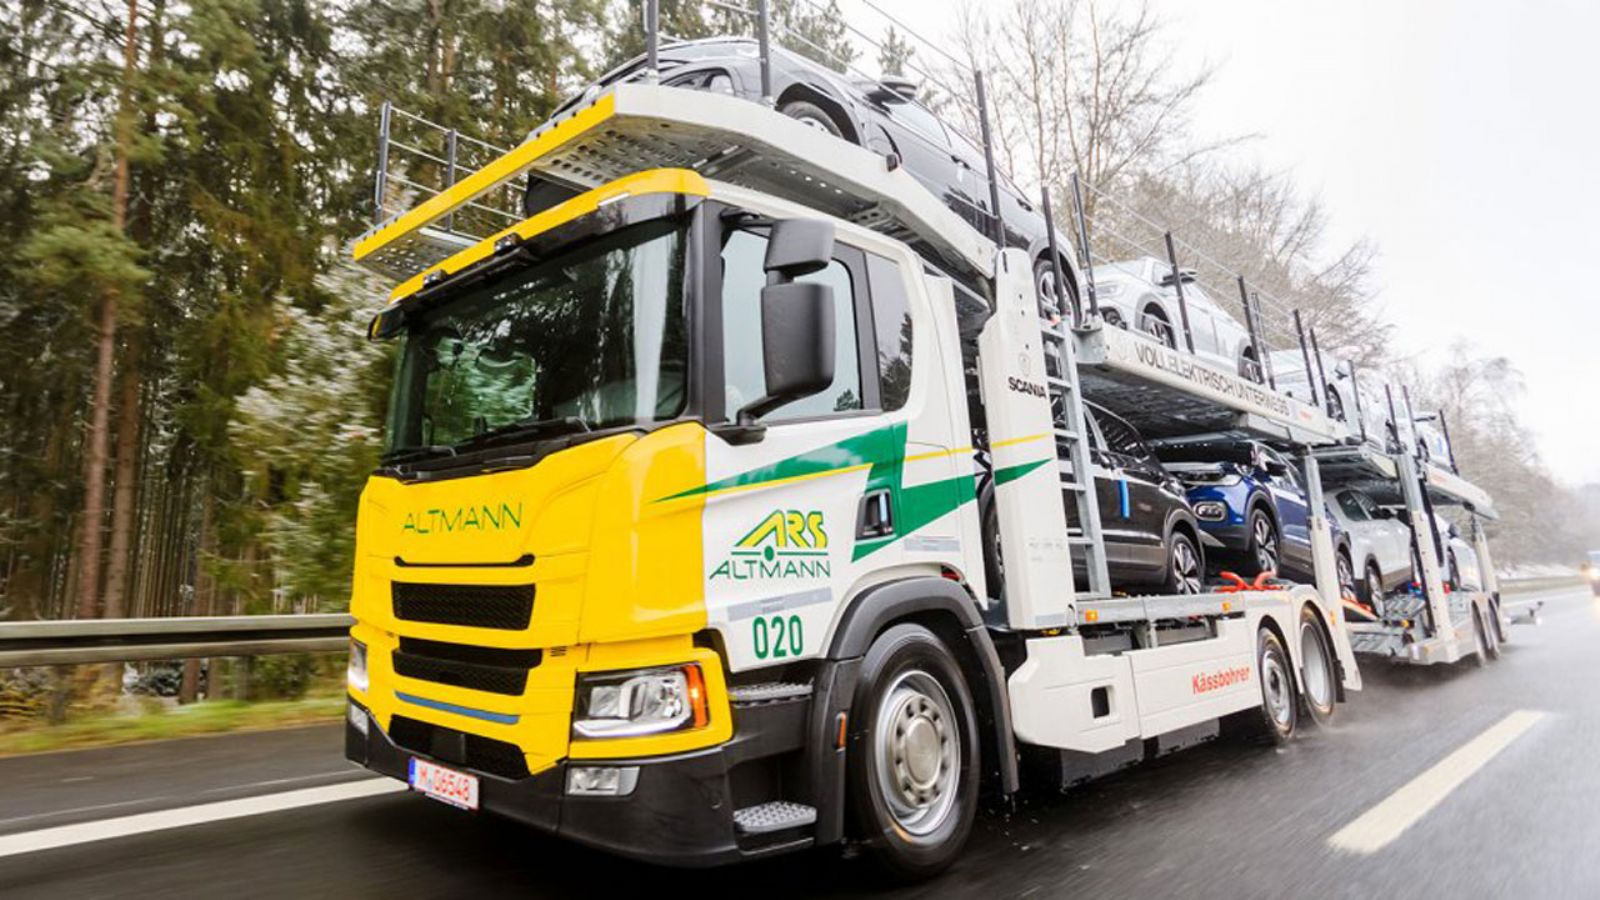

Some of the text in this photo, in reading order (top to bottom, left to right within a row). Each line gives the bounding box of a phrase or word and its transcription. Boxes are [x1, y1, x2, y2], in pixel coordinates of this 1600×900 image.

[1007, 375, 1047, 399] SCANIA
[402, 501, 523, 534] ALTMANN
[733, 509, 829, 548] ARS
[709, 559, 831, 580] ALTMANN
[752, 614, 804, 660] 020
